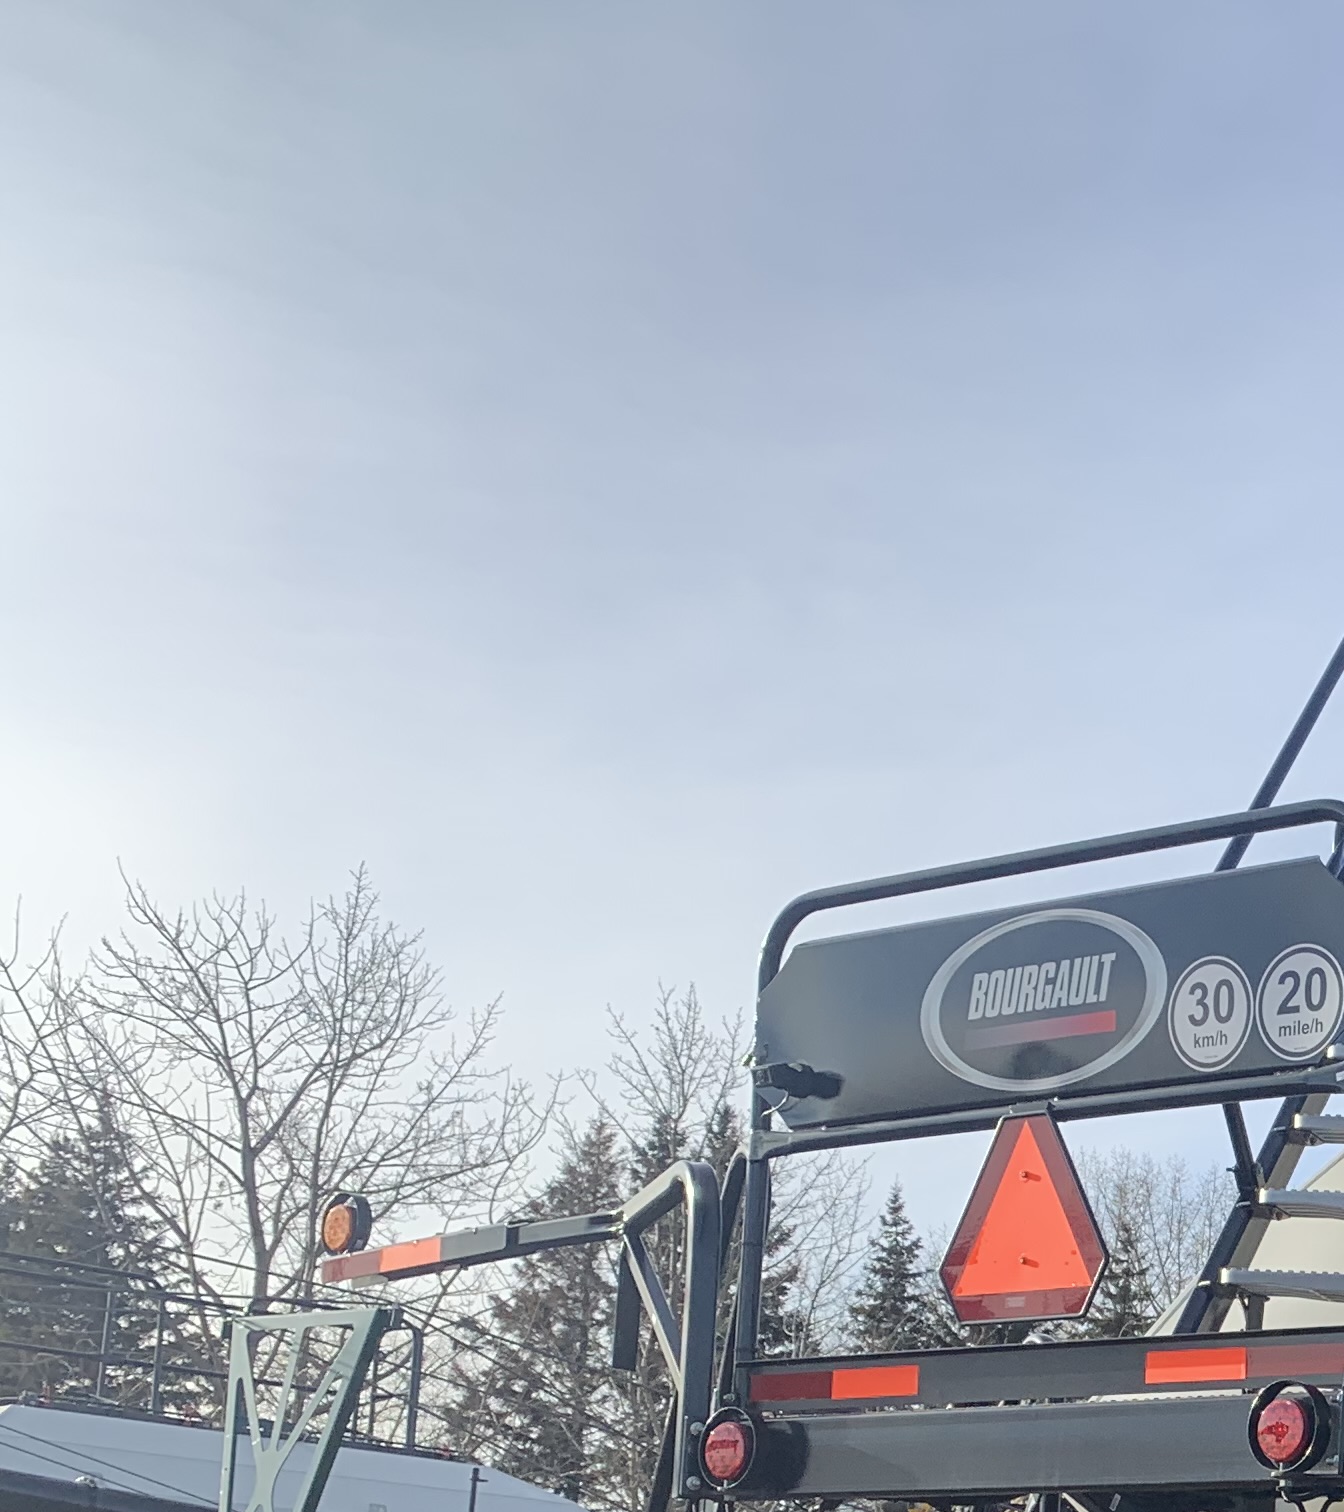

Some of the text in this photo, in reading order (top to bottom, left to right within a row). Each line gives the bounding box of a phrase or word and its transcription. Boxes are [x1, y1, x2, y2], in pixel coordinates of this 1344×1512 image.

[968, 952, 1117, 1020] BOURGAULT
[1188, 978, 1235, 1027] 30
[1277, 966, 1327, 1016] 20
[1193, 1030, 1228, 1048] km/h
[1278, 1018, 1324, 1037] mile/h
